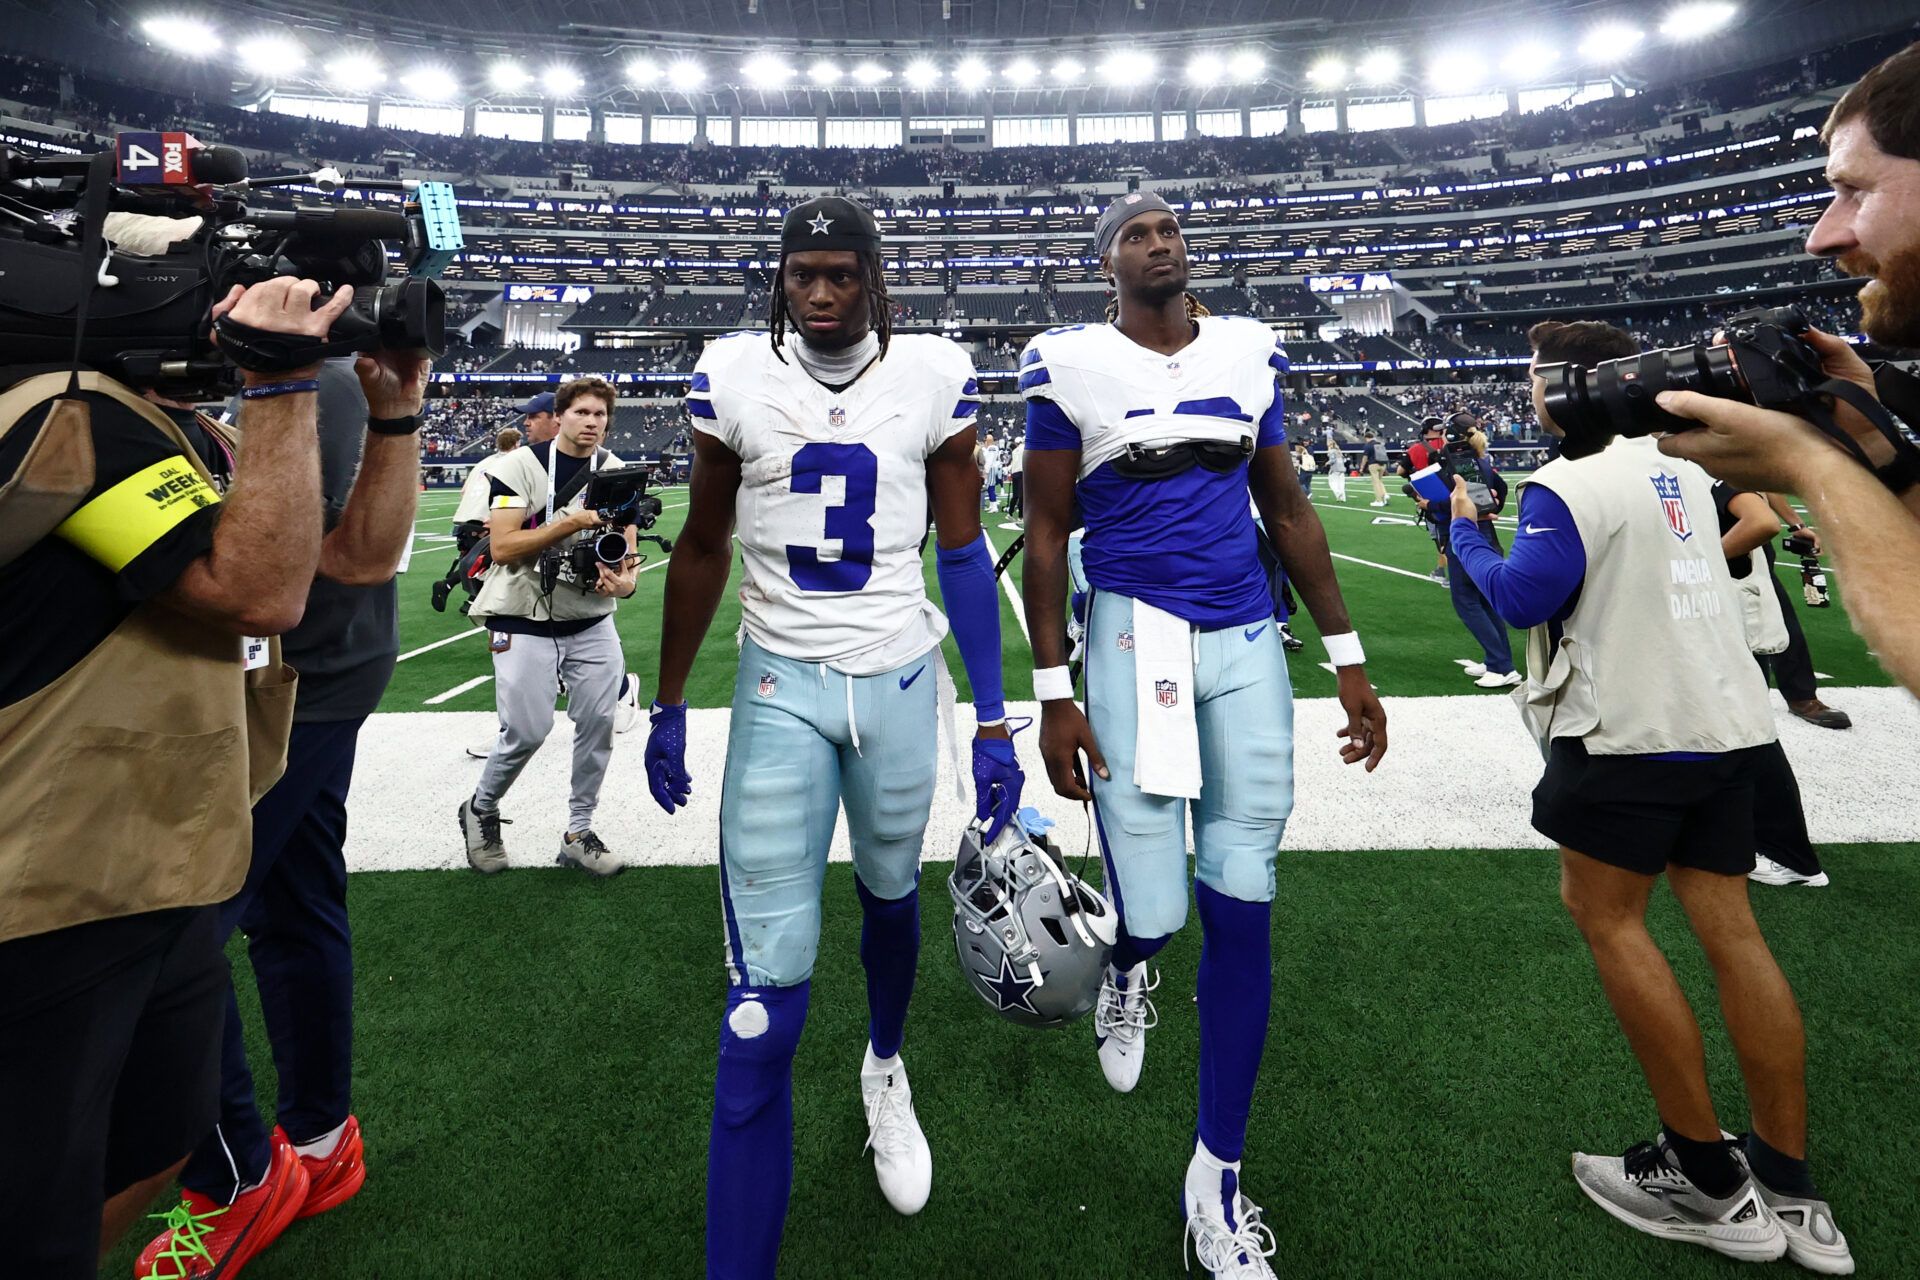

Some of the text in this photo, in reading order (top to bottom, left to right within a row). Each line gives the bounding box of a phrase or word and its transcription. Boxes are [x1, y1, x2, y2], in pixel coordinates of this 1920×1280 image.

[21, 138, 38, 147] THE
[40, 143, 81, 155] COWBOYS
[122, 144, 159, 171] 4
[164, 143, 183, 173] FOX
[136, 275, 179, 283] SONY
[831, 415, 845, 423] NFL
[159, 467, 180, 479] DAL
[145, 472, 200, 502] WEEK
[786, 443, 877, 591] 3
[1664, 500, 1686, 534] NF
[1119, 640, 1132, 649] NFL
[759, 683, 774, 693] NFL
[1158, 691, 1176, 705] NFL
